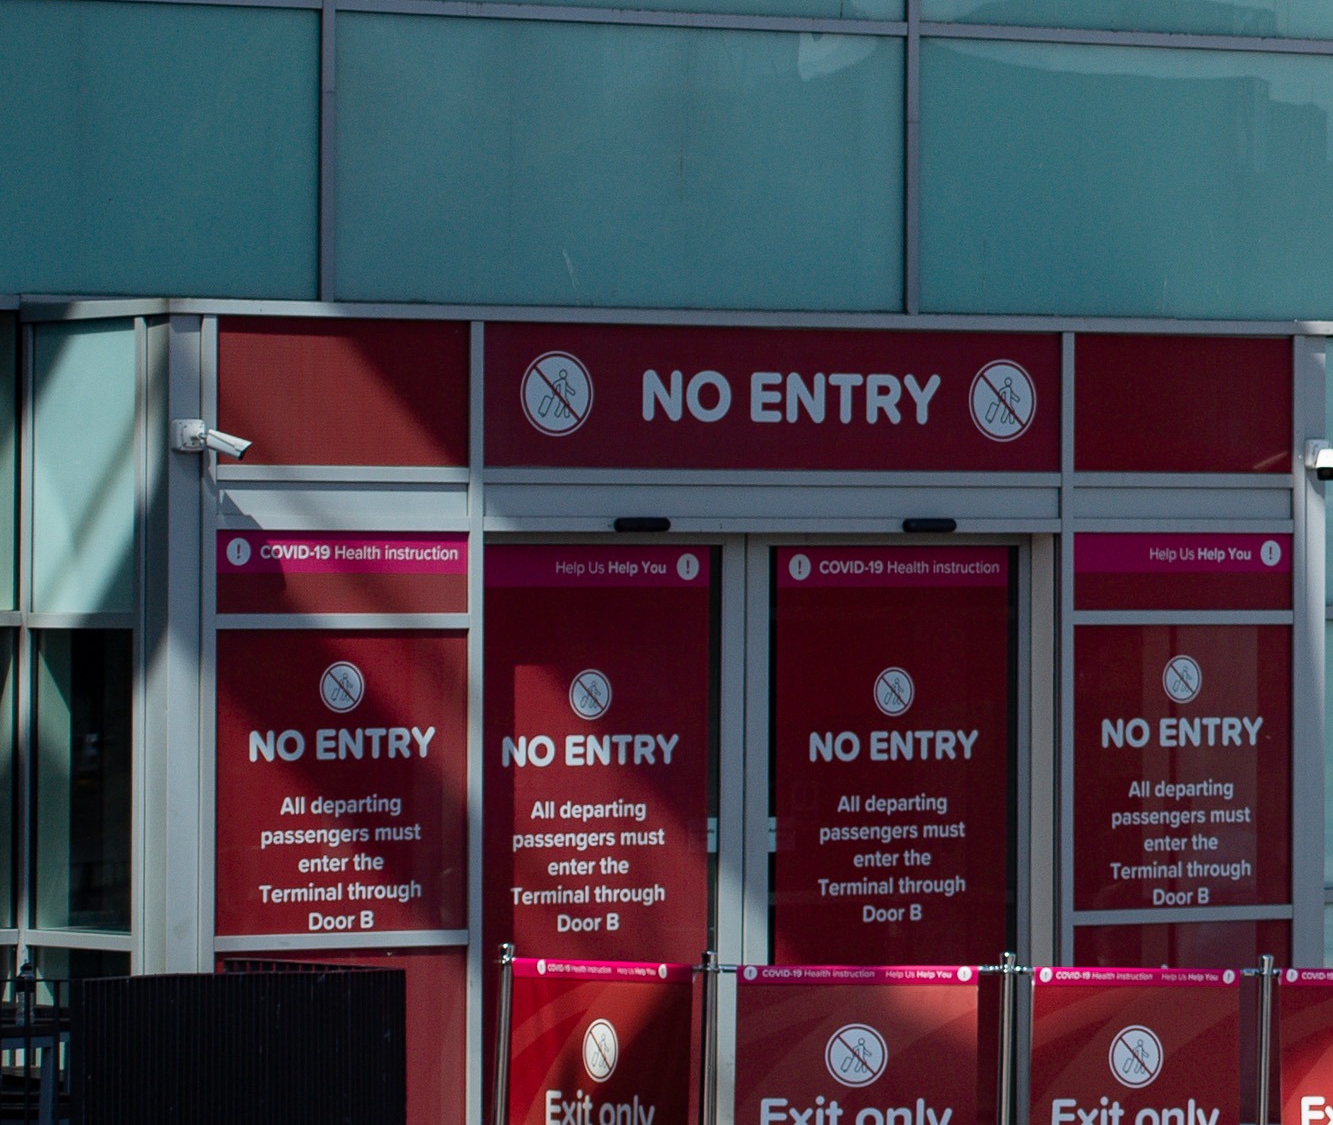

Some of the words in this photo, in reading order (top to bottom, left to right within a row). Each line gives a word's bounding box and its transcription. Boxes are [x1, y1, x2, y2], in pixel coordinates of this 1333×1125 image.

[642, 369, 732, 422] NO
[750, 372, 941, 425] ENTRY
[261, 544, 331, 560] COVID-19
[335, 546, 381, 560] Health
[385, 545, 458, 561] instruction
[1150, 548, 1177, 562] Help
[1179, 548, 1195, 560] Us
[1197, 547, 1226, 563] Help
[1228, 547, 1252, 560] You
[556, 562, 585, 576] Help
[589, 562, 605, 574] Us
[608, 561, 638, 576] Help
[641, 561, 666, 574] You
[819, 560, 883, 574] COVID-19
[887, 561, 929, 574] Health
[933, 562, 999, 574] instruction
[1102, 718, 1150, 748] NO
[1159, 716, 1263, 747] ENTRY
[249, 730, 305, 763] NO
[316, 726, 436, 760] ENTRY
[503, 735, 555, 767] NO
[565, 734, 678, 766] ENTRY
[809, 731, 860, 762] NO
[870, 729, 978, 761] ENTRY
[1128, 780, 1150, 797] All
[1154, 778, 1234, 801] departing
[280, 796, 305, 815] All
[310, 794, 401, 818] departing
[531, 801, 555, 819] All
[560, 799, 646, 822] departing
[837, 795, 860, 812] All
[865, 793, 947, 815] departing
[1112, 810, 1206, 829] passengers
[1210, 806, 1251, 823] must
[261, 828, 369, 849] passengers
[375, 824, 421, 840] must
[513, 832, 616, 852] passengers
[620, 828, 665, 845] must
[820, 825, 918, 845] passengers
[923, 821, 965, 838] must
[1144, 836, 1188, 852] enter
[1191, 833, 1219, 851] the
[298, 855, 349, 873] enter
[353, 853, 383, 871] the
[548, 858, 596, 876] enter
[599, 856, 629, 874] the
[853, 851, 899, 867] enter
[903, 849, 932, 866] the
[1110, 861, 1182, 879] Terminal
[1186, 859, 1252, 881] through
[259, 882, 342, 903] Terminal
[347, 881, 421, 902] through
[511, 885, 590, 905] Terminal
[594, 884, 665, 906] through
[818, 877, 893, 896] Terminal
[898, 875, 966, 897] through
[1153, 888, 1193, 905] Door
[1198, 887, 1210, 905] B
[308, 912, 356, 931] Door
[360, 910, 374, 929] B
[557, 914, 602, 932] Door
[606, 913, 619, 931] B
[863, 905, 905, 922] Door
[910, 904, 922, 921] B
[545, 1089, 593, 1125] Exit
[760, 1095, 843, 1125] Exit
[1051, 1096, 1124, 1125] Exit
